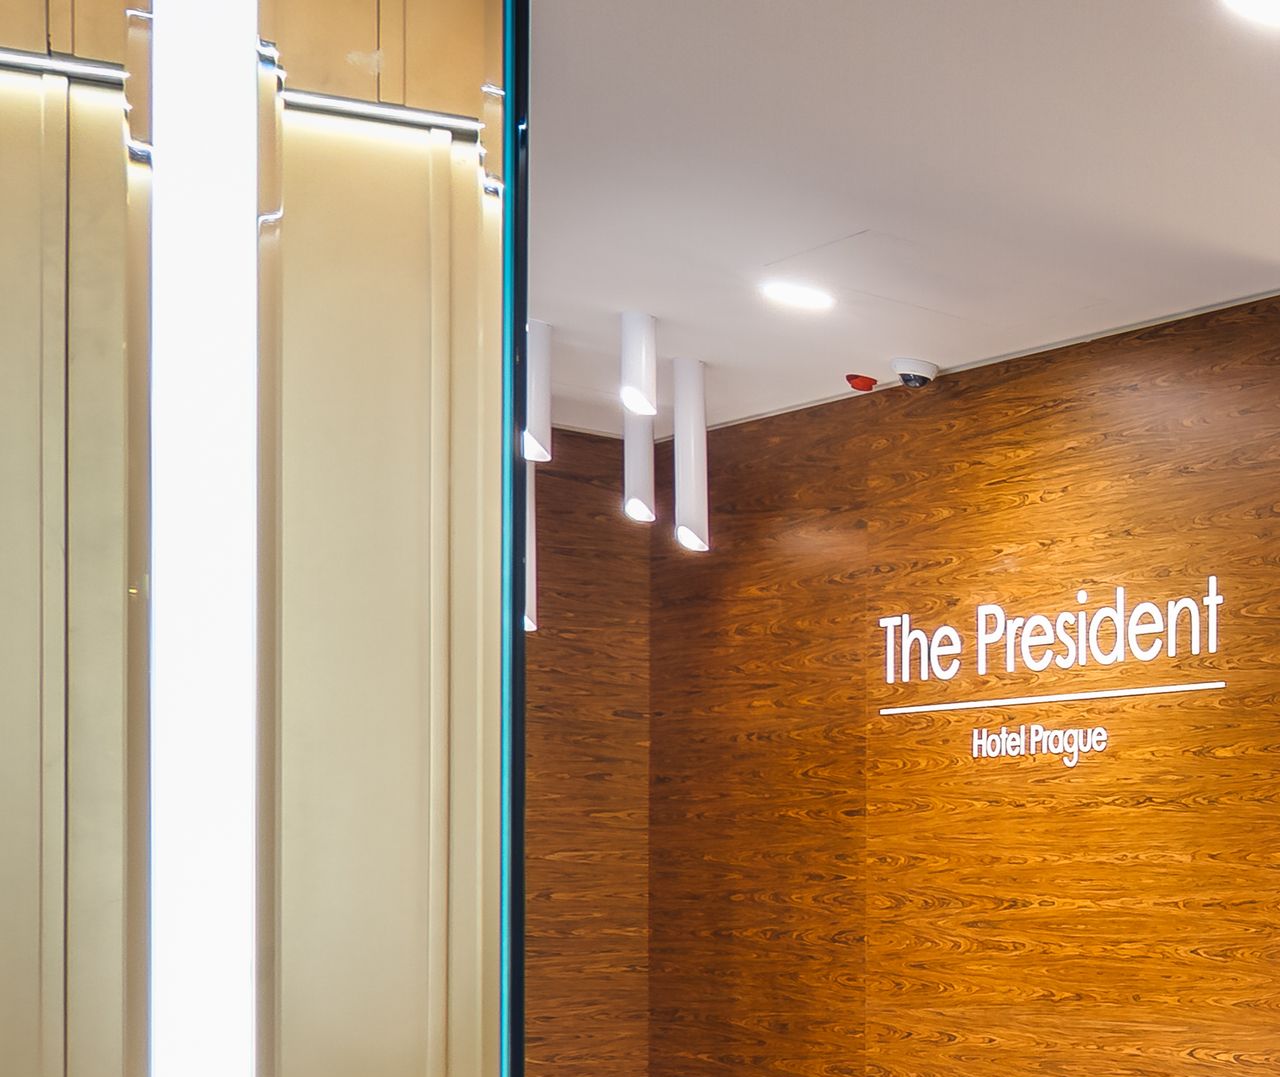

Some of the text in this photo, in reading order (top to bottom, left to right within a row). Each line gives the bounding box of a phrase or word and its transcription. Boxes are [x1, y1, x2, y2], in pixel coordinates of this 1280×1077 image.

[878, 575, 1224, 684] The President
[972, 724, 1108, 768] Hotel Prague
